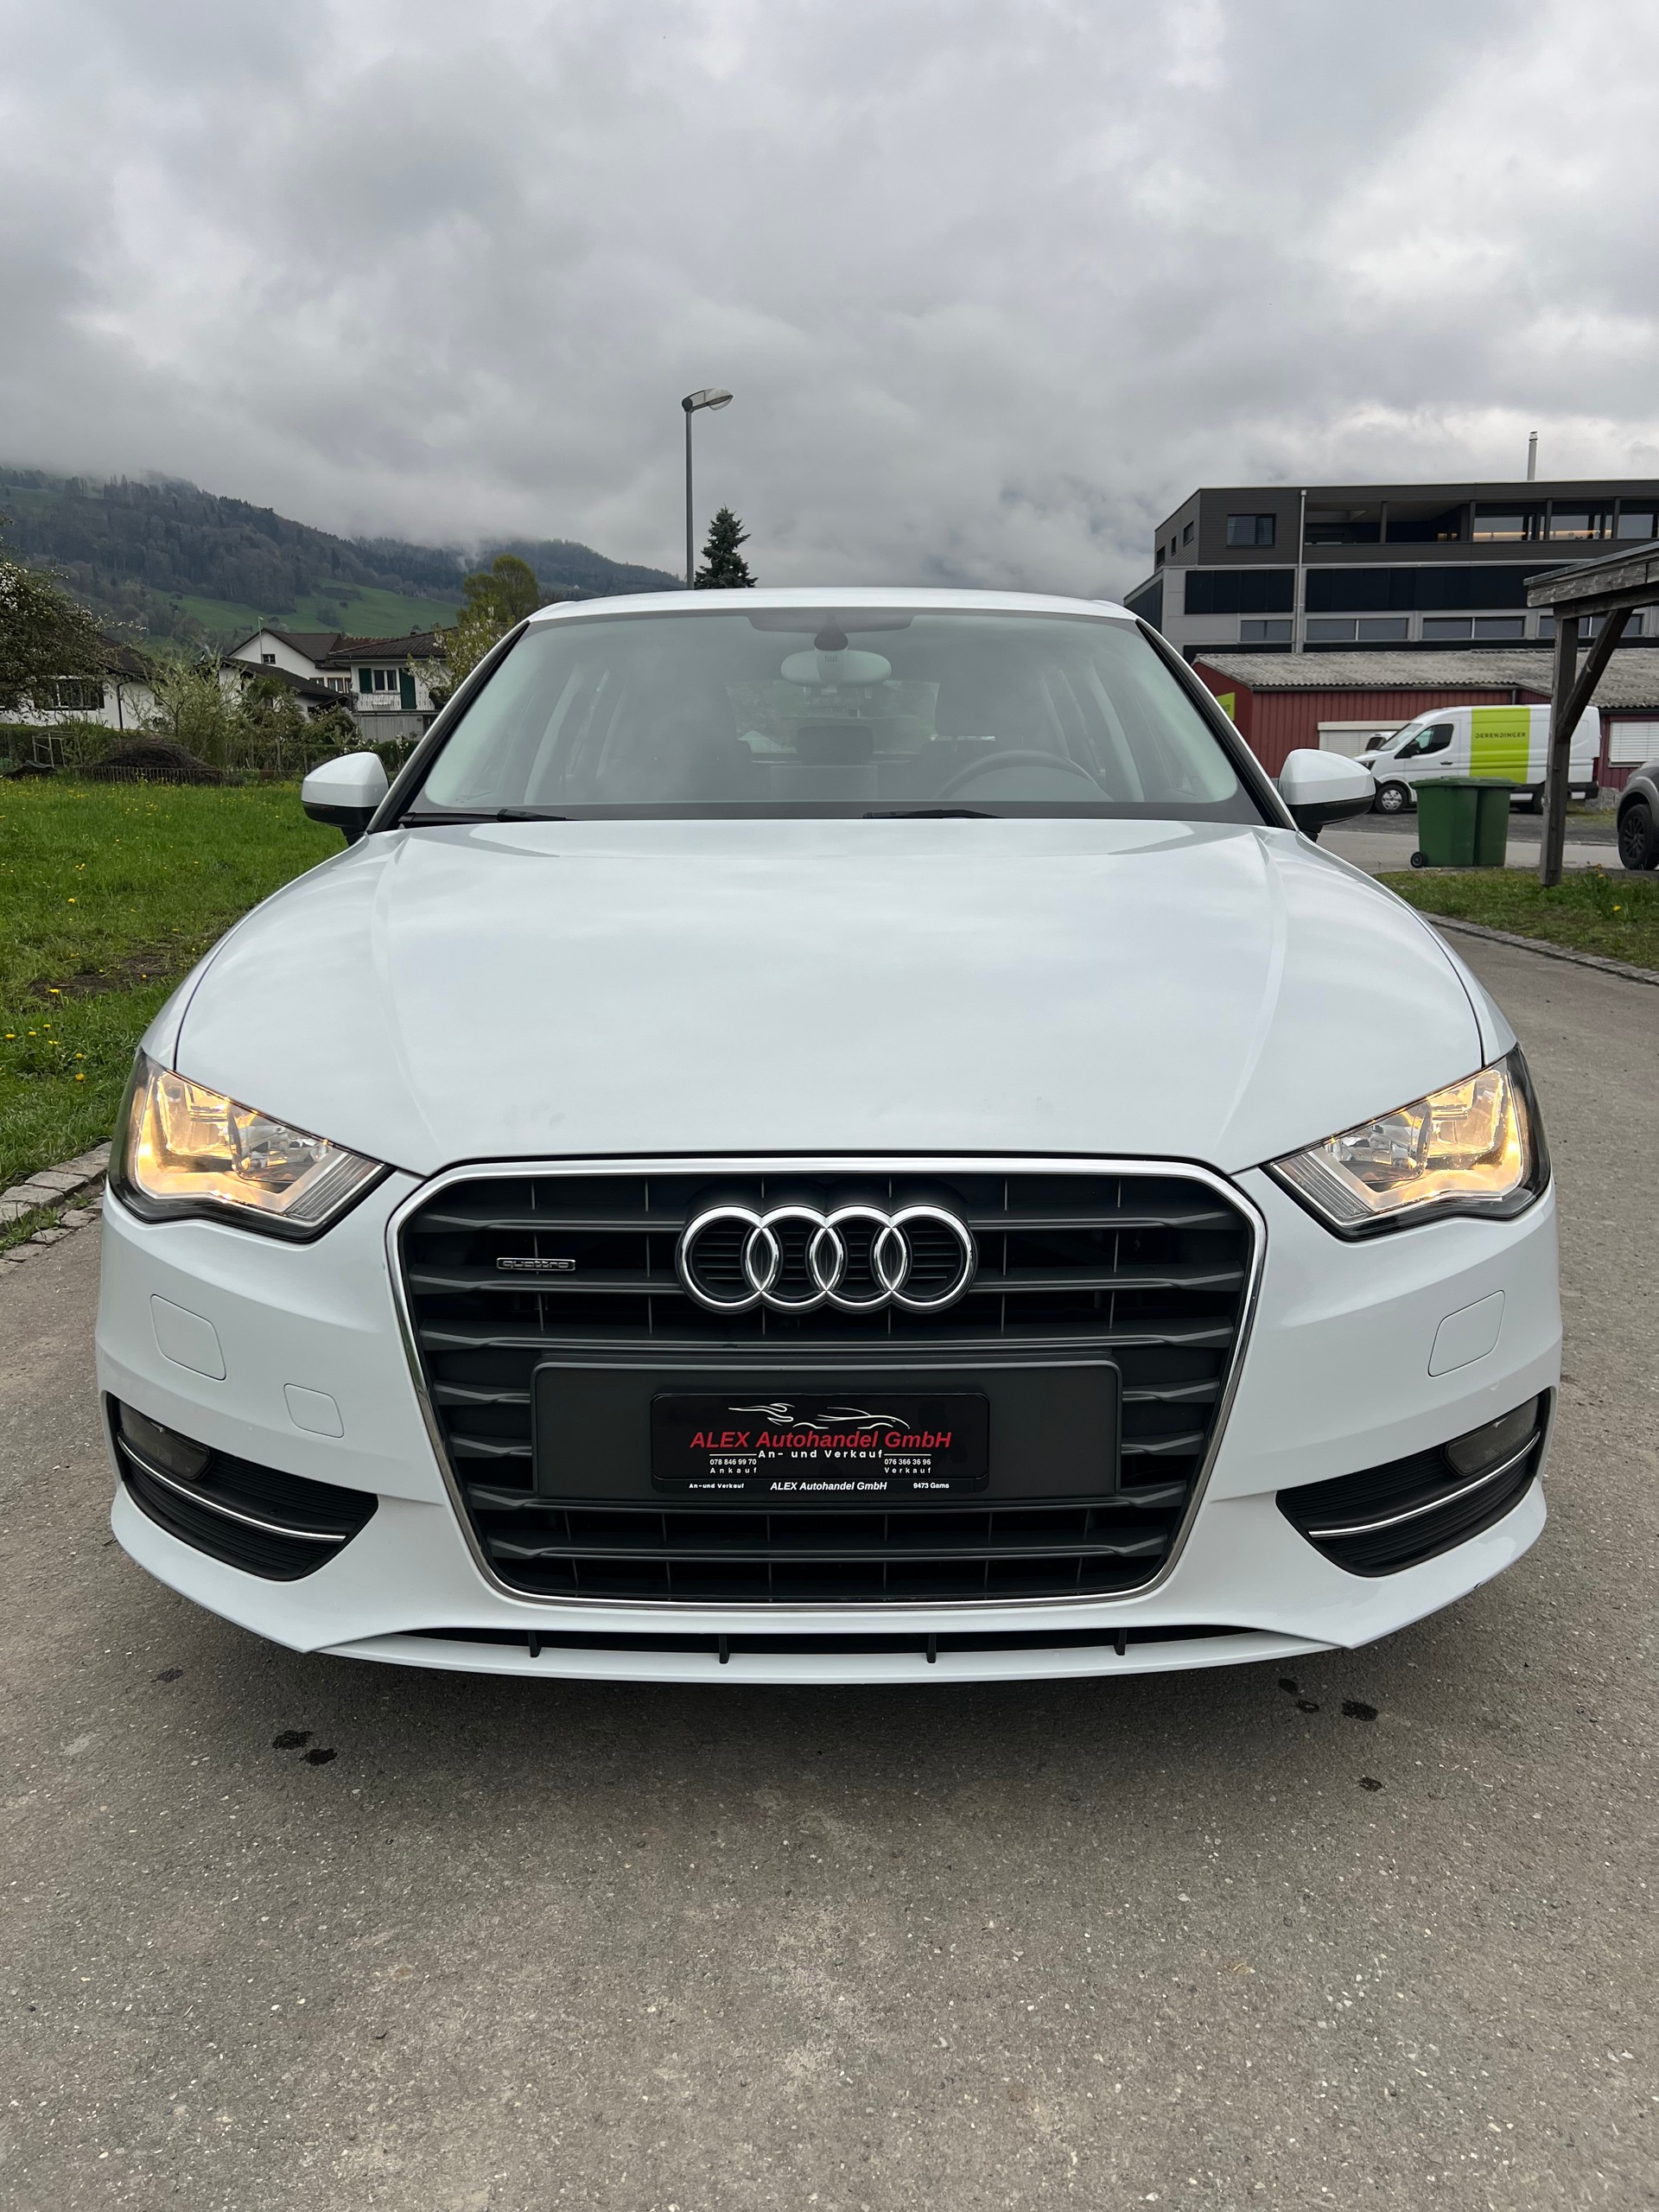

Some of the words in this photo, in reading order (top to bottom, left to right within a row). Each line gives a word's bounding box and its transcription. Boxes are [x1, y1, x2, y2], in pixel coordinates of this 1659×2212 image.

[690, 1432, 751, 1448] ALEX
[755, 1431, 879, 1448] Autohandel
[884, 1432, 951, 1448] GmbH
[758, 1450, 784, 1459] An-
[791, 1450, 817, 1459] und
[824, 1449, 883, 1459] Verkauf
[770, 1482, 798, 1491] ALEX
[799, 1482, 855, 1491] Autohandel
[856, 1482, 887, 1491] GmbH
